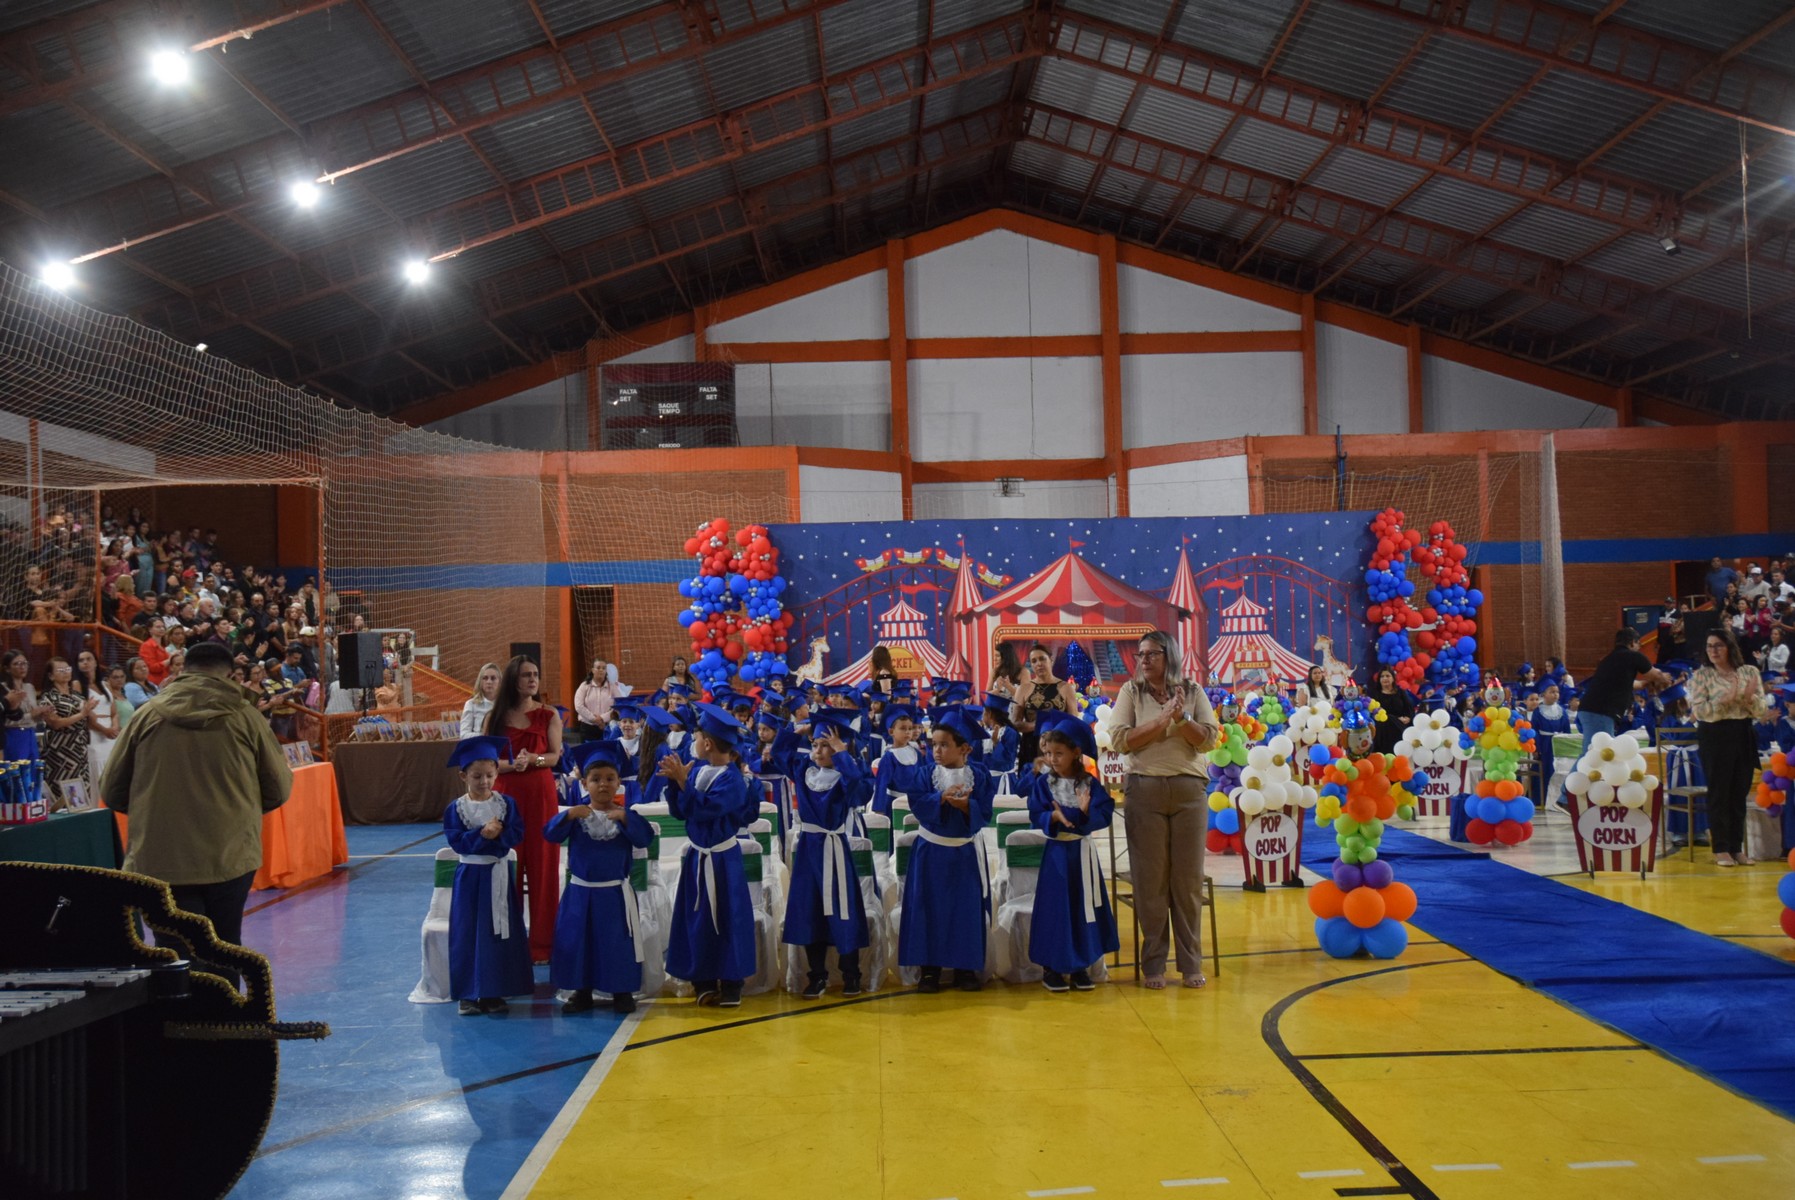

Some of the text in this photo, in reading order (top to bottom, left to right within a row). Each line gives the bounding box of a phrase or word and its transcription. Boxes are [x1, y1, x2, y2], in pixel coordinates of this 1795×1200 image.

[1107, 750, 1120, 761] POP
[1104, 763, 1124, 774] CORN
[1423, 766, 1444, 779] POP
[1600, 805, 1629, 823] POP
[1260, 815, 1281, 834] POP
[1593, 827, 1637, 845] CORN
[1255, 836, 1287, 857] CORN
